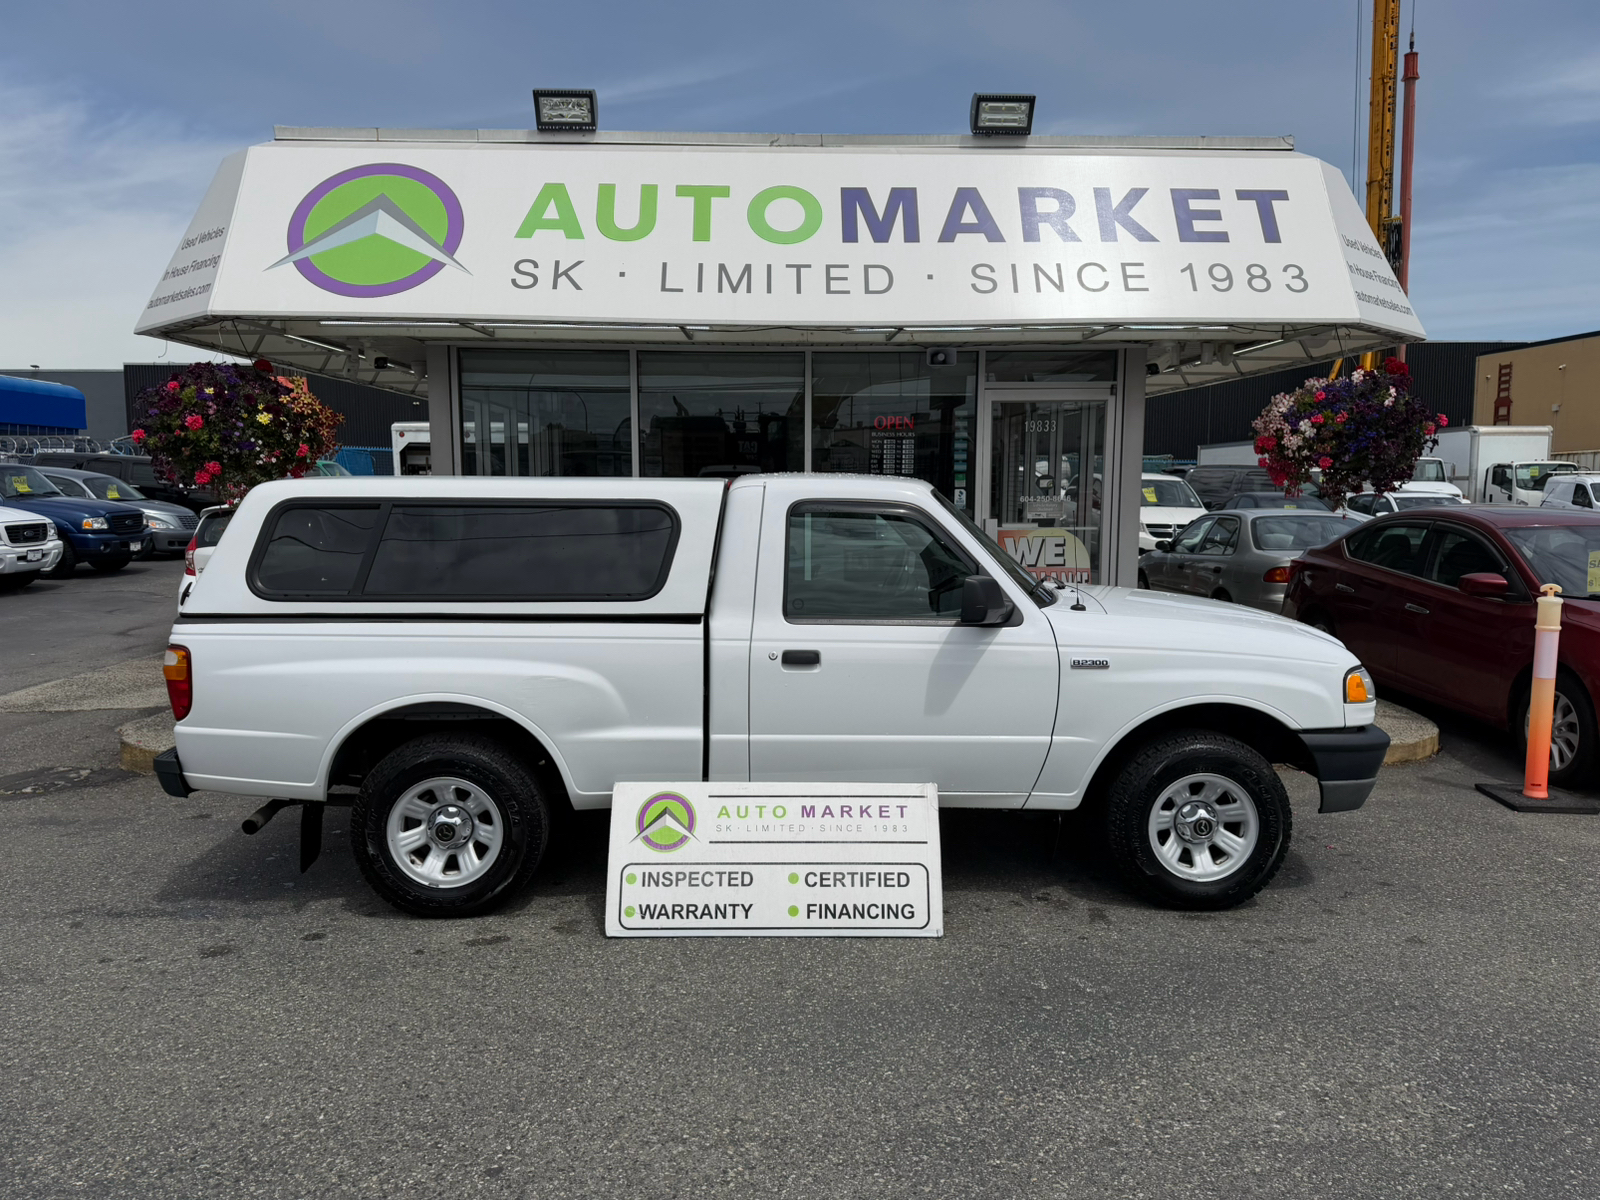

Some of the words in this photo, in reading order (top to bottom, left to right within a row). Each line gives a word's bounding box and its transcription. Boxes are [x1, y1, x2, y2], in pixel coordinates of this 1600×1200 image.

[181, 234, 198, 251] Used
[198, 226, 225, 245] Vehicles
[1341, 233, 1360, 252] Used
[1356, 239, 1383, 260] Vehicles
[169, 264, 190, 280] House
[188, 253, 221, 274] Financing
[510, 258, 585, 291] SK
[659, 262, 894, 295] LIMITED
[970, 262, 1150, 294] SINCE
[1180, 262, 1309, 294] 1983
[1354, 263, 1375, 281] House
[1371, 269, 1402, 293] Financing
[146, 282, 212, 310] automarketsales.com
[1355, 290, 1415, 317] automarketsales.com
[873, 415, 915, 430] OPEN
[1024, 420, 1057, 433] 19833
[1003, 536, 1066, 568] WE
[716, 805, 788, 819] AUTO
[800, 805, 909, 819] MARKET
[715, 824, 733, 832] SK
[746, 824, 806, 833] LIMITED
[819, 824, 863, 833] SINCE
[873, 824, 909, 833] 1983
[641, 870, 754, 888] INSPECTED
[804, 870, 911, 888] CERTIFIED
[638, 903, 754, 920] WARRANTY
[806, 903, 916, 920] FINANCING
